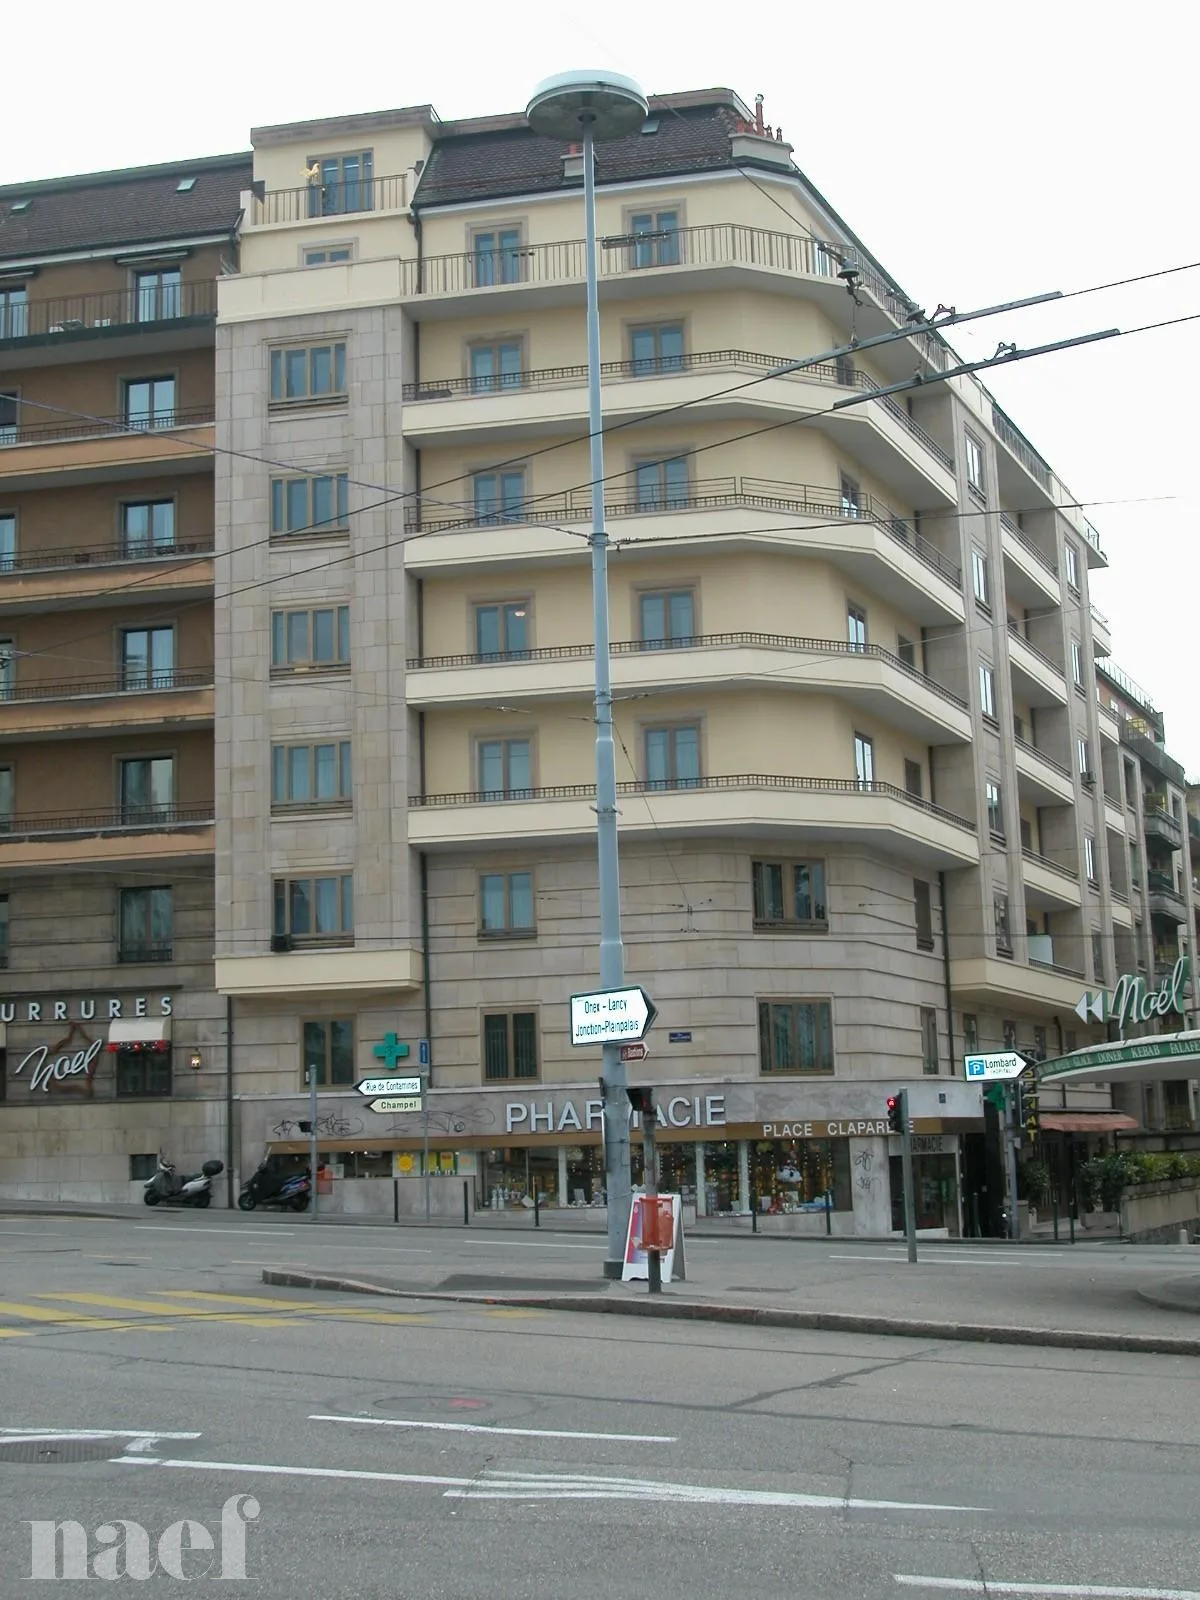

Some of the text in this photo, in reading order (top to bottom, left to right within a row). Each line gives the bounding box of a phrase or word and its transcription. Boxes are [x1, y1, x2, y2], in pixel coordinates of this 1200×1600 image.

[608, 998, 628, 1013] Lancy
[1130, 1044, 1161, 1058] KEBAB
[984, 1058, 1017, 1069] Lombard
[366, 1082, 376, 1091] Rue
[378, 1082, 385, 1091] de
[380, 1100, 417, 1110] Champel
[763, 1123, 813, 1138] PLACE
